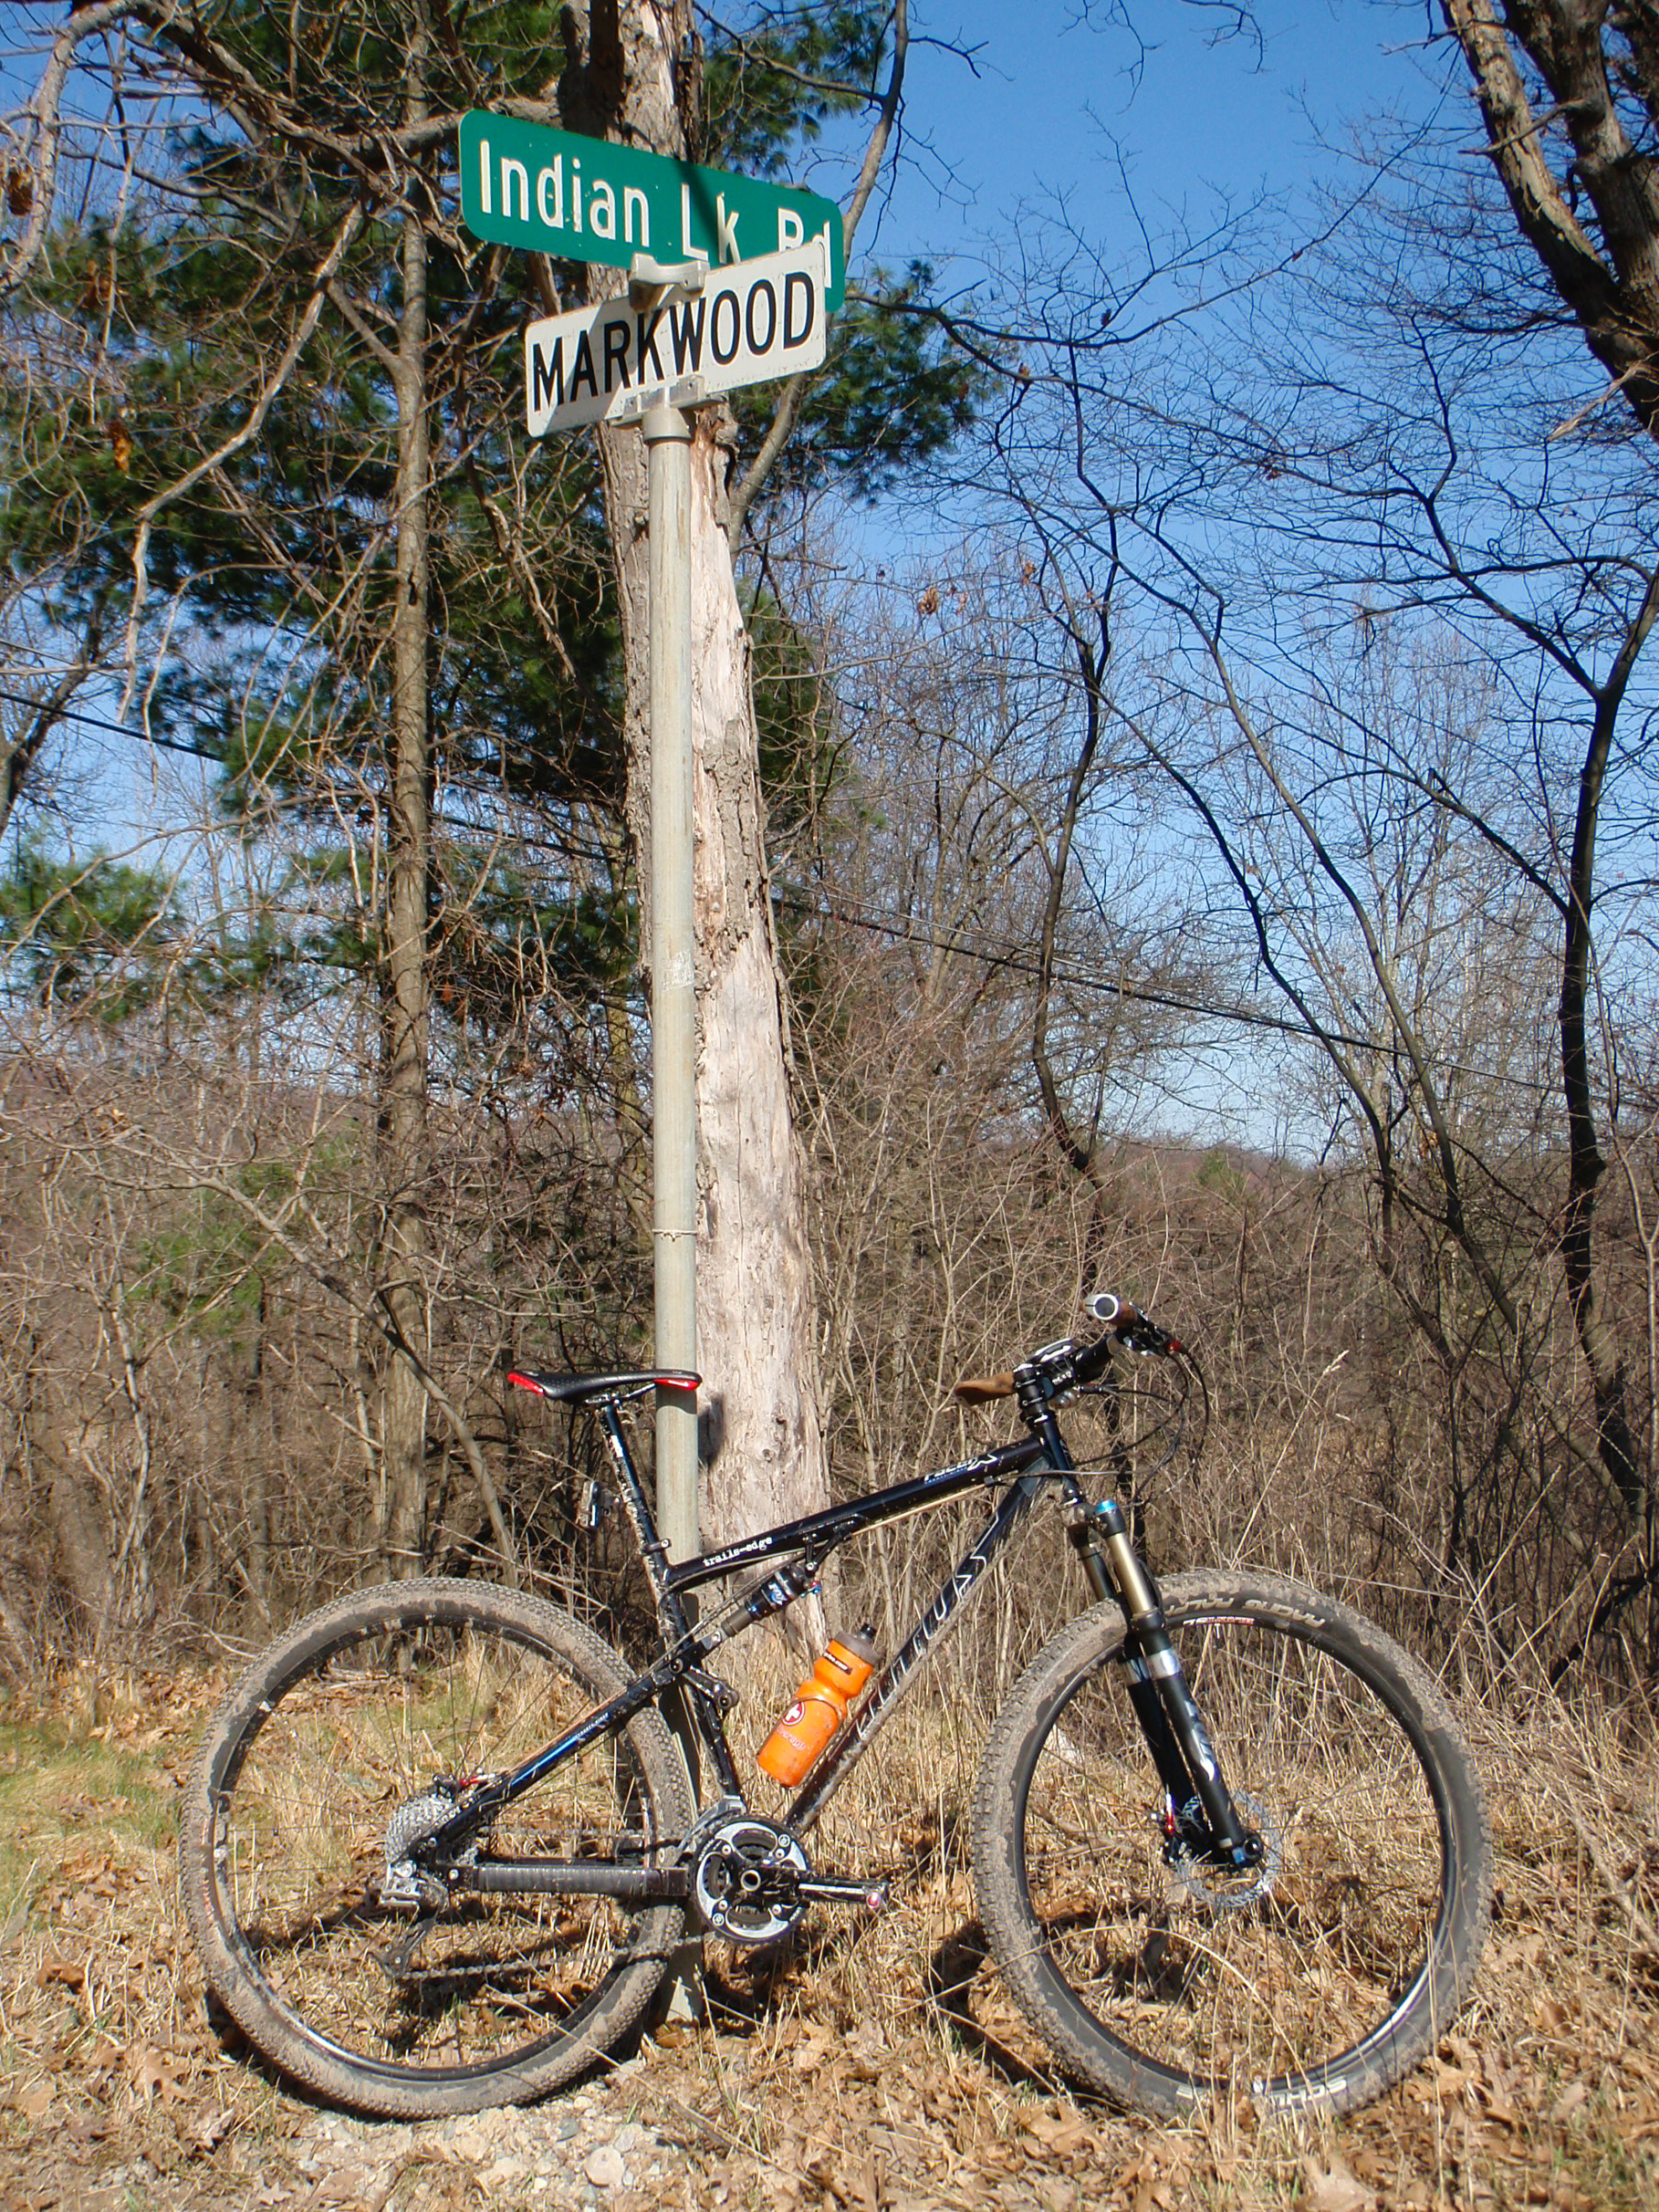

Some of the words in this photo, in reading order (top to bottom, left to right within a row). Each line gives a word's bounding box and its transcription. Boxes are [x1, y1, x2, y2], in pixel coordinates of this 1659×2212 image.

[480, 140, 650, 247] Indian
[681, 183, 742, 265] Lk
[532, 271, 815, 412] MARKWOOD
[702, 1537, 773, 1568] trails-edge
